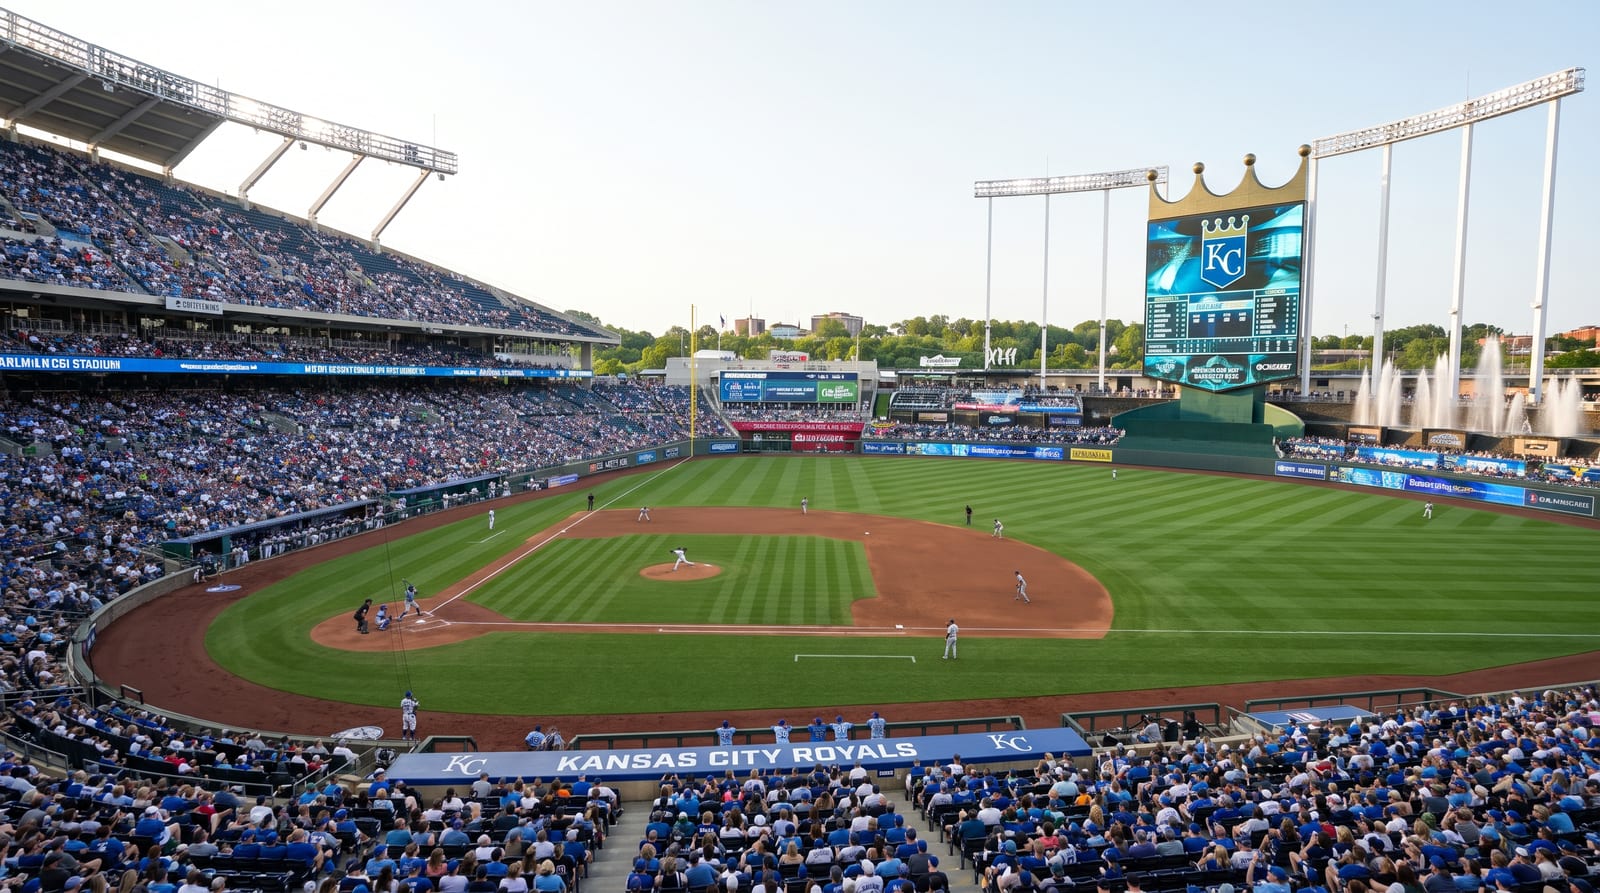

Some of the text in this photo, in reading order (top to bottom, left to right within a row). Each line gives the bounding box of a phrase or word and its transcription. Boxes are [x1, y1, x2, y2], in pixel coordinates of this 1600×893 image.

[1205, 243, 1242, 276] KC
[441, 734, 1033, 776] KC KANSAS CITY ROYALS KC
